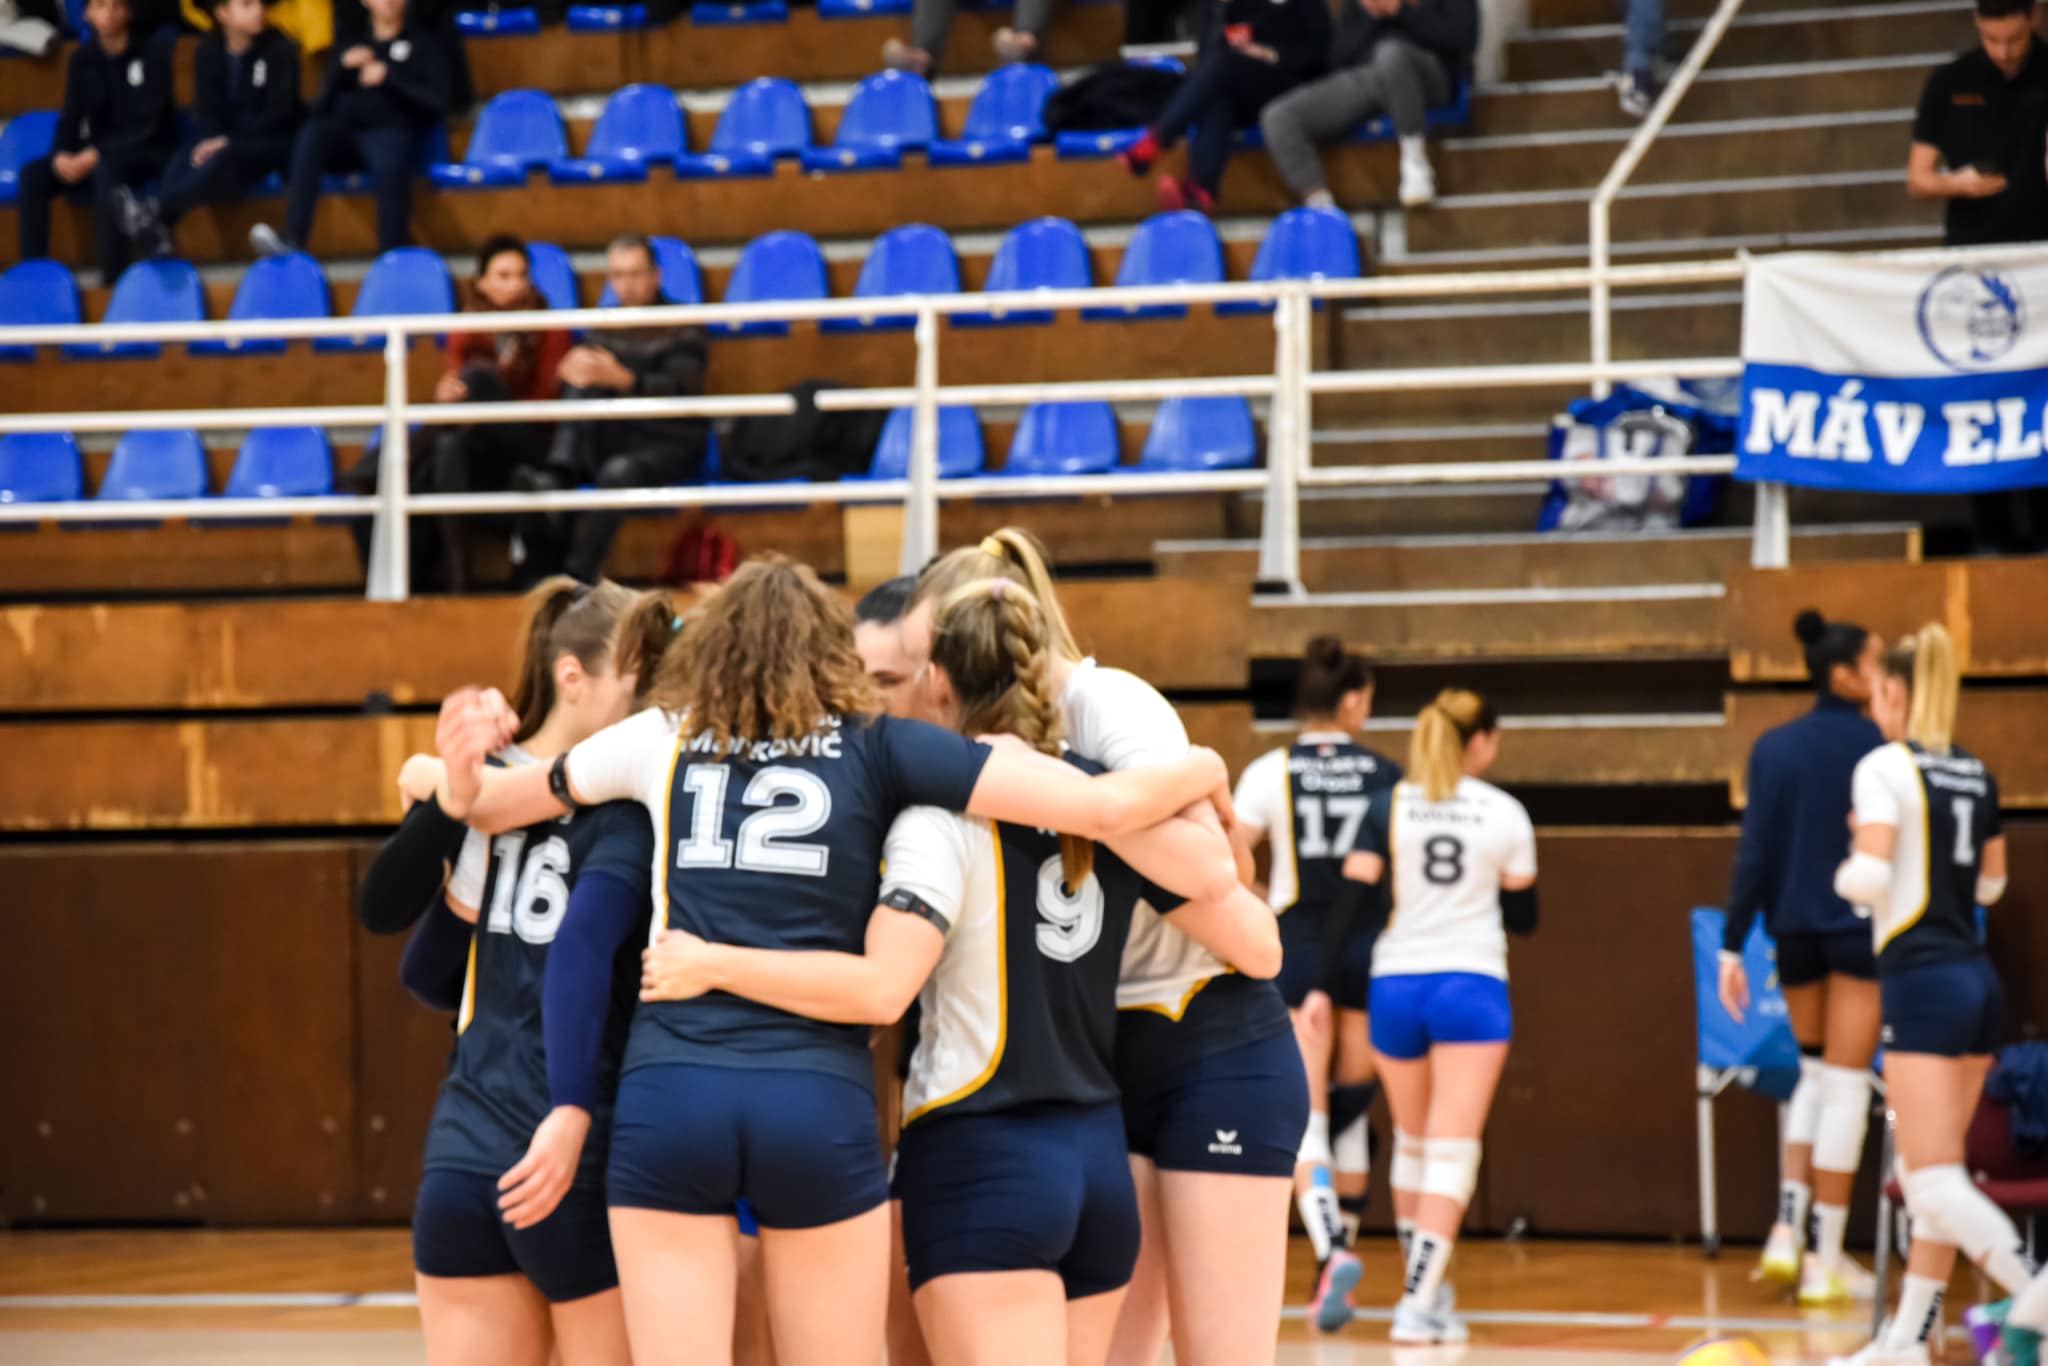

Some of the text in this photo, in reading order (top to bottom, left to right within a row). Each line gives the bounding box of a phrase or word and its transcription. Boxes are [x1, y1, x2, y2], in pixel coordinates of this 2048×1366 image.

[1745, 379, 2048, 466] MÁV EL
[677, 763, 832, 877] 12
[1296, 795, 1369, 859] 17
[1423, 835, 1464, 885] 8
[1952, 797, 1975, 865] 1
[487, 829, 571, 945] 16
[1035, 853, 1105, 963] 9
